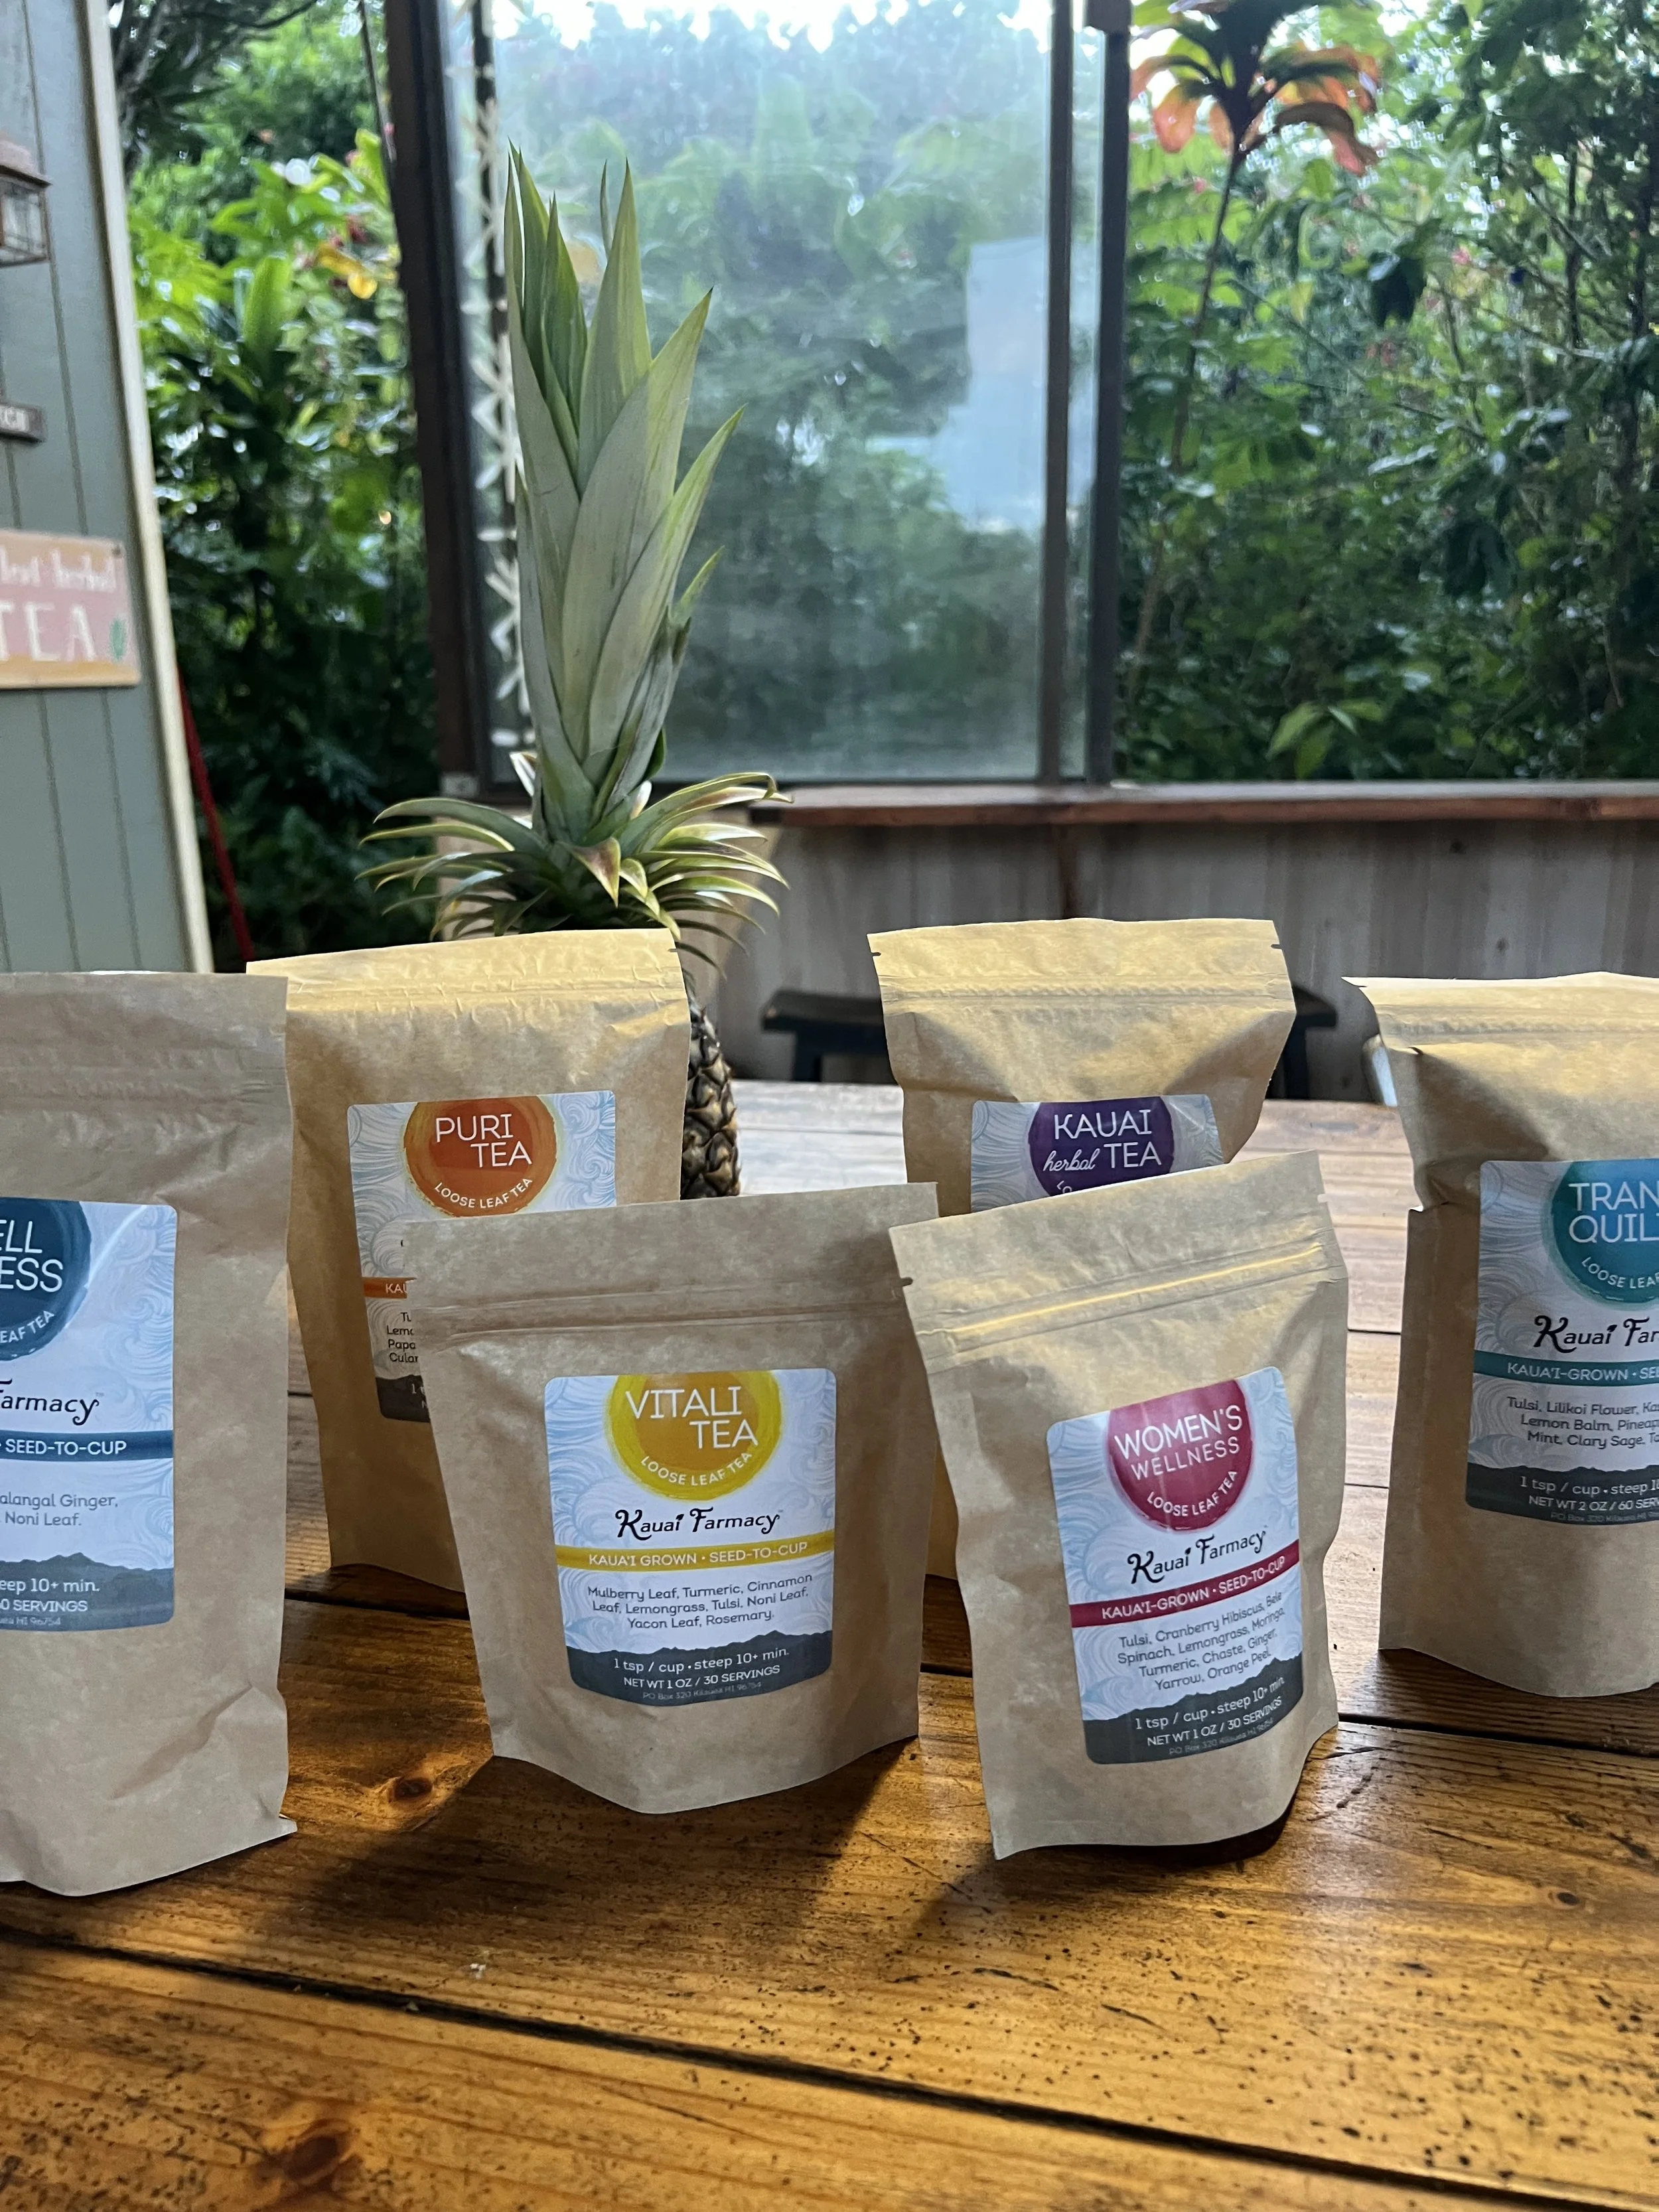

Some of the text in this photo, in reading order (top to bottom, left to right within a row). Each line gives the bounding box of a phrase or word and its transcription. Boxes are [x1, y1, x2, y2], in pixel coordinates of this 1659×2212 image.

[0, 601, 97, 662] TEA
[436, 1114, 513, 1142] PURI
[1054, 1109, 1151, 1140] KAUAI
[470, 1141, 532, 1167] TEA
[1043, 1141, 1162, 1171] herbal TEA
[435, 1178, 533, 1209] LOOSE LEAF TEA
[1569, 1213, 1659, 1243] QUIL
[1581, 1256, 1626, 1288] LOOSE
[27, 1310, 55, 1334] TEA
[1534, 1315, 1617, 1353] Kauai
[625, 1386, 742, 1419] VITALI
[1547, 1402, 1586, 1414] Lilikoi
[689, 1419, 758, 1449] TEA
[1114, 1405, 1242, 1459] WOMEN'S
[1521, 1414, 1569, 1430] Lemon
[1574, 1420, 1613, 1431] Balm,
[5, 1438, 127, 1455] SEED-TO-CUP
[1567, 1435, 1606, 1449] Clary
[640, 1452, 753, 1486] LOOSE LEAF TEA
[1131, 1436, 1240, 1480] WELLNESS
[1147, 1471, 1238, 1516] LOOSE LEAF TEA
[1520, 1476, 1527, 1487] 1
[1532, 1479, 1556, 1493] tsp
[1572, 1486, 1600, 1497] cup
[1611, 1483, 1648, 1495] steep
[60, 1495, 117, 1511] Ginger,
[1529, 1495, 1554, 1507] NET
[1556, 1500, 1577, 1510] WT
[1579, 1502, 1585, 1511] 2
[1589, 1502, 1607, 1511] OZ
[1618, 1501, 1633, 1510] 60
[5, 1511, 82, 1526] Noni Leaf.
[615, 1507, 780, 1540] Kauai Farmacy
[589, 1542, 807, 1566] KAUA'I GROWN SEED-TO-CUP
[1127, 1534, 1265, 1584] Kauai Farmacy
[31, 1578, 59, 1591] 10+
[63, 1580, 100, 1592] min.
[587, 1574, 812, 1602] Mulberry Leaf, Turmeric, Cinnamon
[1218, 1556, 1285, 1593] SEED-TO-CUP
[13, 1599, 88, 1612] SERVINGS
[593, 1601, 621, 1613] Leaf,
[626, 1603, 708, 1616] Lemongrass,
[711, 1598, 743, 1610] Tulsi,
[747, 1593, 776, 1606] Noni
[627, 1610, 774, 1629] Yacon Leaf, Rosemary.
[1155, 1619, 1219, 1642] Cranberry
[614, 1659, 619, 1668] 1
[624, 1660, 644, 1674] tsp
[658, 1662, 684, 1674] cup
[694, 1657, 733, 1670] steep
[737, 1653, 758, 1664] 10+
[763, 1647, 789, 1660] min.
[1118, 1646, 1175, 1666] Spinach,
[1179, 1627, 1250, 1654] Lemongrass,
[1139, 1658, 1199, 1677] Turmeric,
[1202, 1645, 1246, 1663] Chaste,
[624, 1677, 644, 1688] NET
[646, 1680, 664, 1689] WT
[667, 1680, 672, 1689] 1
[675, 1678, 692, 1688] OZ
[703, 1675, 719, 1684] 30
[721, 1665, 780, 1682] SERVINGS
[1155, 1674, 1204, 1690] Yarrow,
[1208, 1659, 1250, 1679] Orange
[1135, 1718, 1141, 1730] 1
[1145, 1718, 1169, 1730] tsp
[1183, 1710, 1208, 1722] cup
[1217, 1696, 1251, 1714] steep
[1147, 1734, 1171, 1746] NET
[1172, 1731, 1190, 1742] WT
[1193, 1728, 1198, 1739] 1
[1200, 1725, 1217, 1737] OZ
[1228, 1718, 1241, 1730] 30
[1243, 1696, 1282, 1725] SERVINGS
